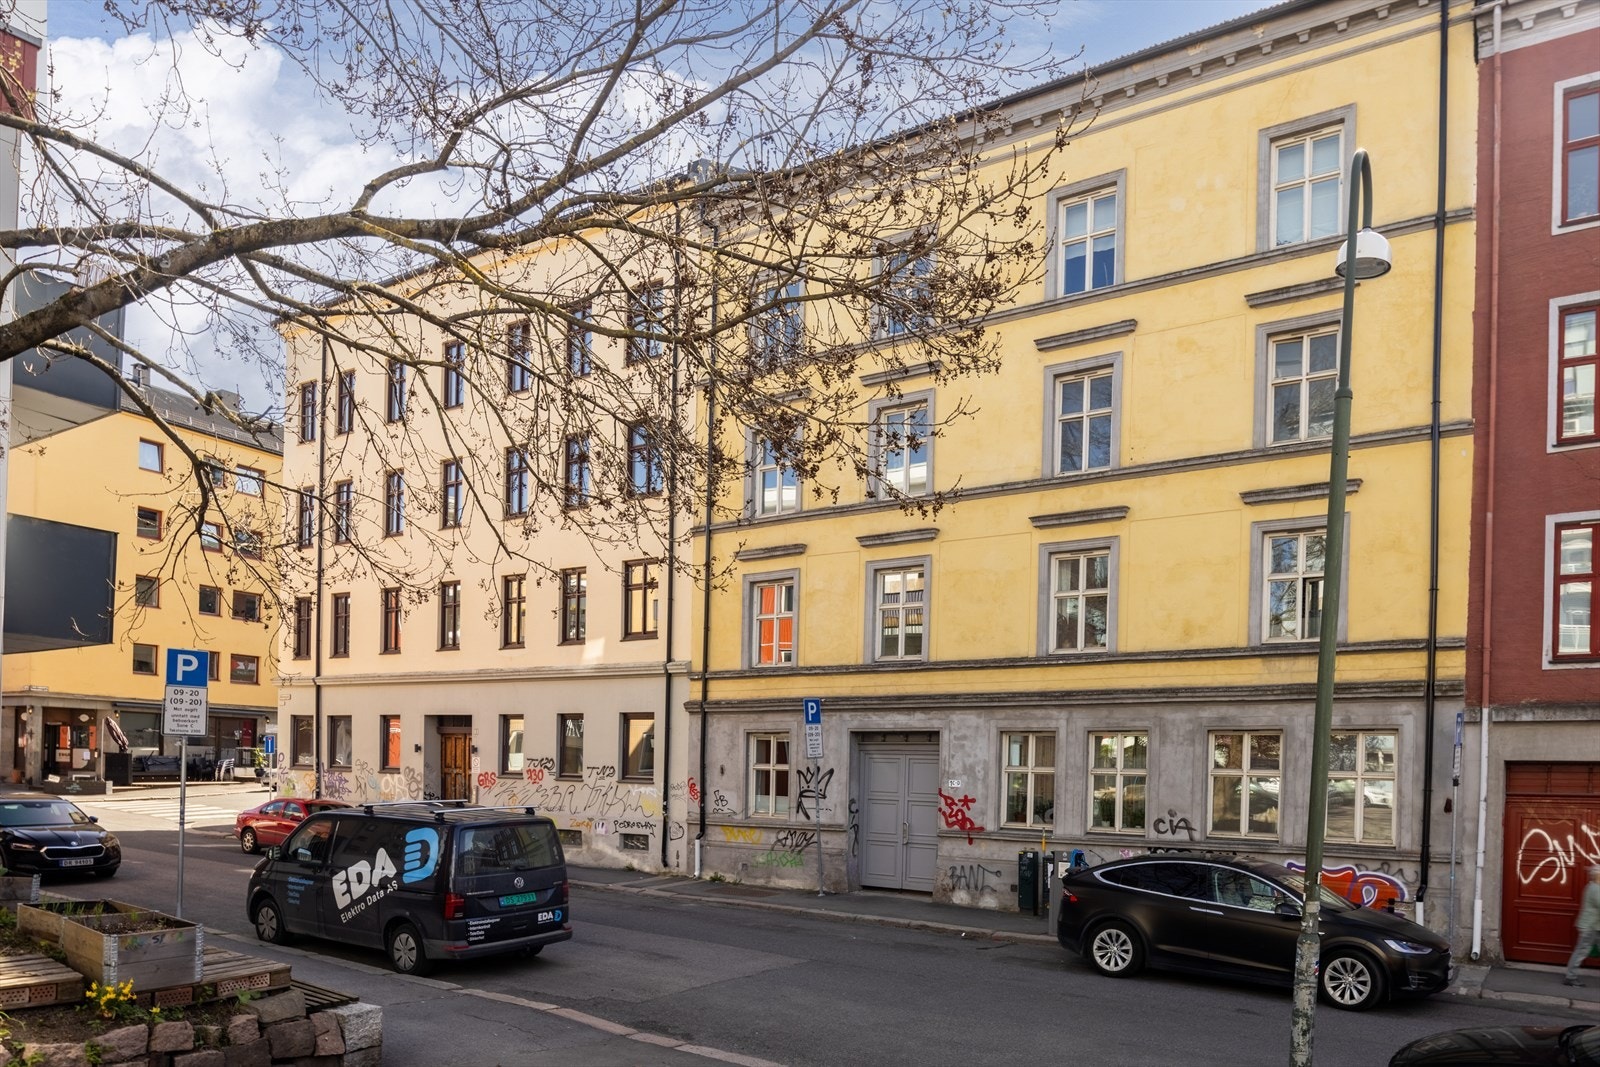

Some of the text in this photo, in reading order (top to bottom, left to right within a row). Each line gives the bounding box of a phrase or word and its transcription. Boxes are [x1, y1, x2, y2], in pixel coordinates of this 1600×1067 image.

[176, 653, 199, 682] P
[808, 702, 817, 721] P
[332, 847, 398, 910] EDA
[340, 880, 398, 923] Elektro Data AS
[537, 911, 554, 921] EDA
